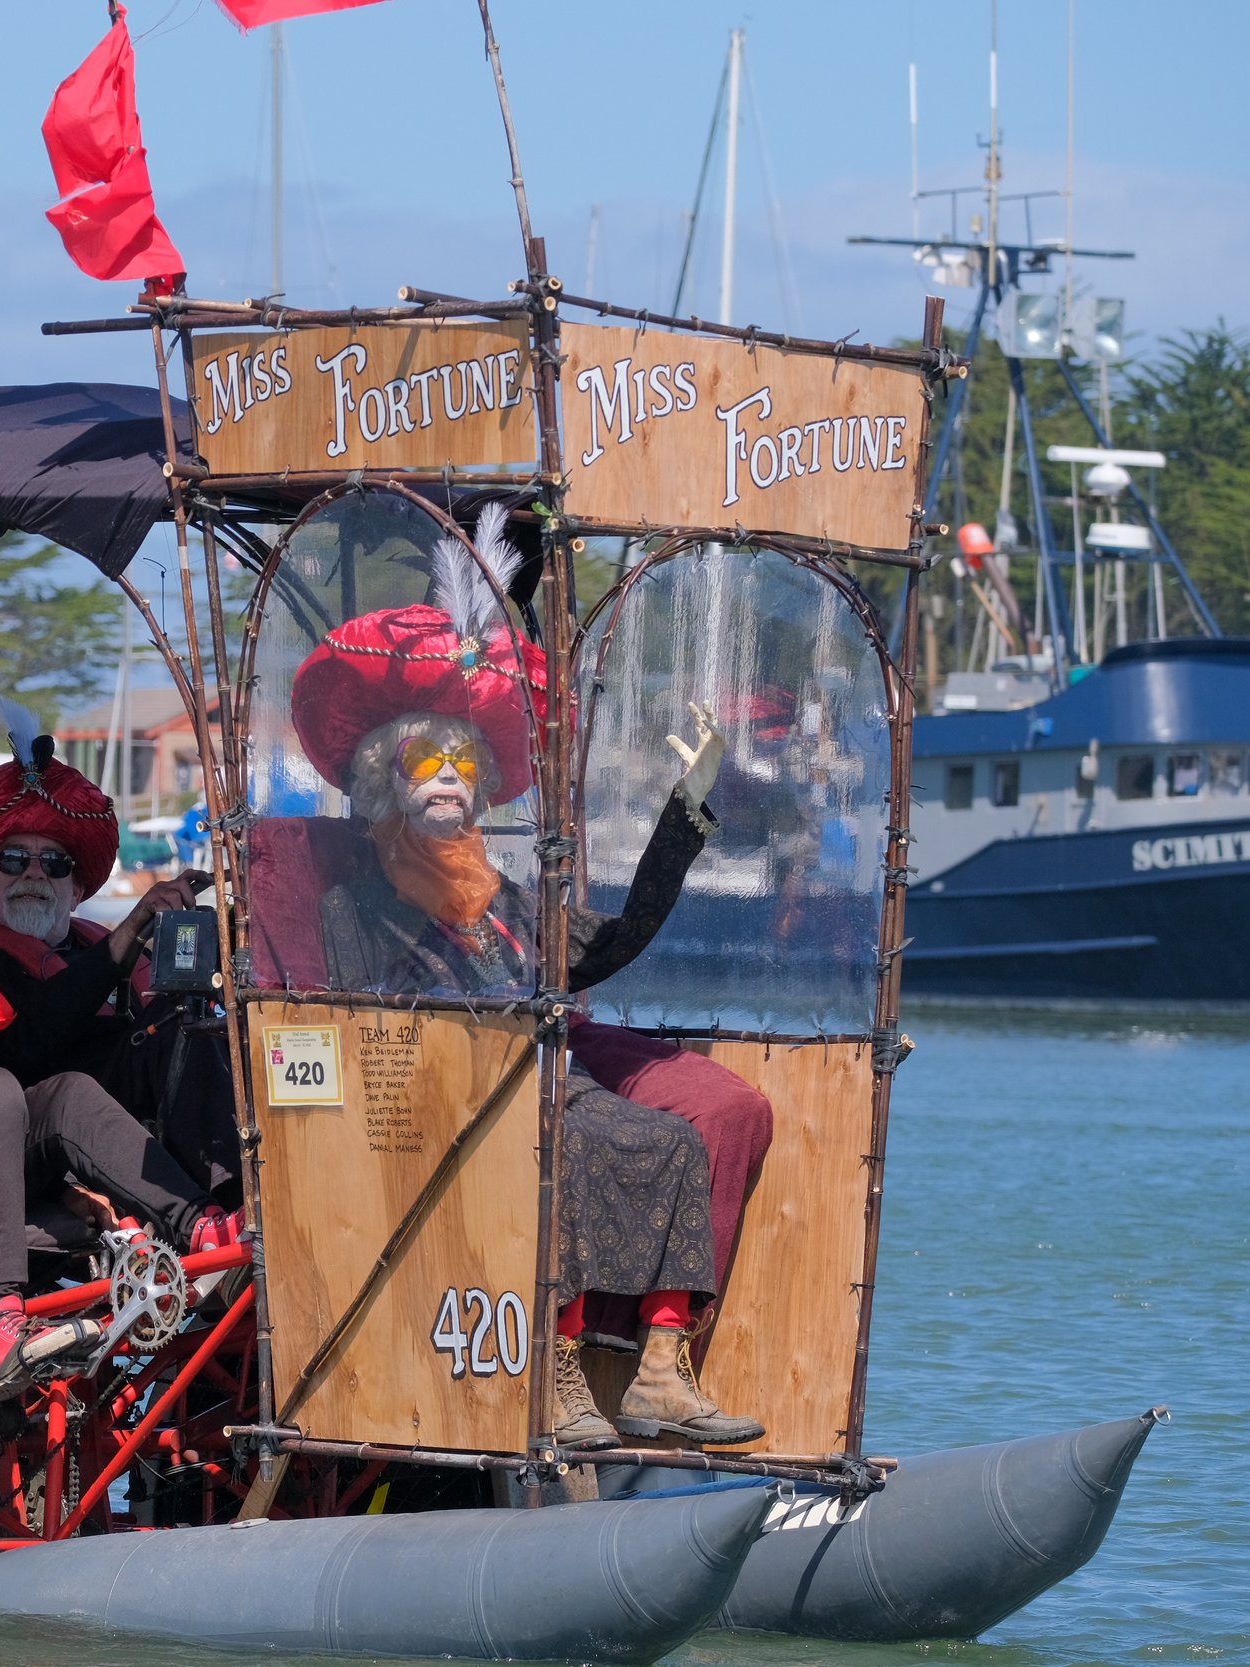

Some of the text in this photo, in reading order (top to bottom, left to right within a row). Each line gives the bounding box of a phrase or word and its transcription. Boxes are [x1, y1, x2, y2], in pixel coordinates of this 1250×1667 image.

[359, 1026, 419, 1044] TEAM 420
[360, 1046, 373, 1056] KEN
[360, 1059, 385, 1067] ROBERT
[285, 1061, 325, 1086] 420
[361, 1069, 376, 1078] TODD
[363, 1080, 406, 1090] BRYCE BAKER
[365, 1093, 380, 1102] DAVE
[365, 1106, 394, 1115] JULIETTE
[367, 1117, 412, 1127] BLAKE ROBERTS
[367, 1129, 424, 1140] CASSIE COLLINS
[395, 1144, 423, 1153] MANESS
[431, 1286, 528, 1380] 420
